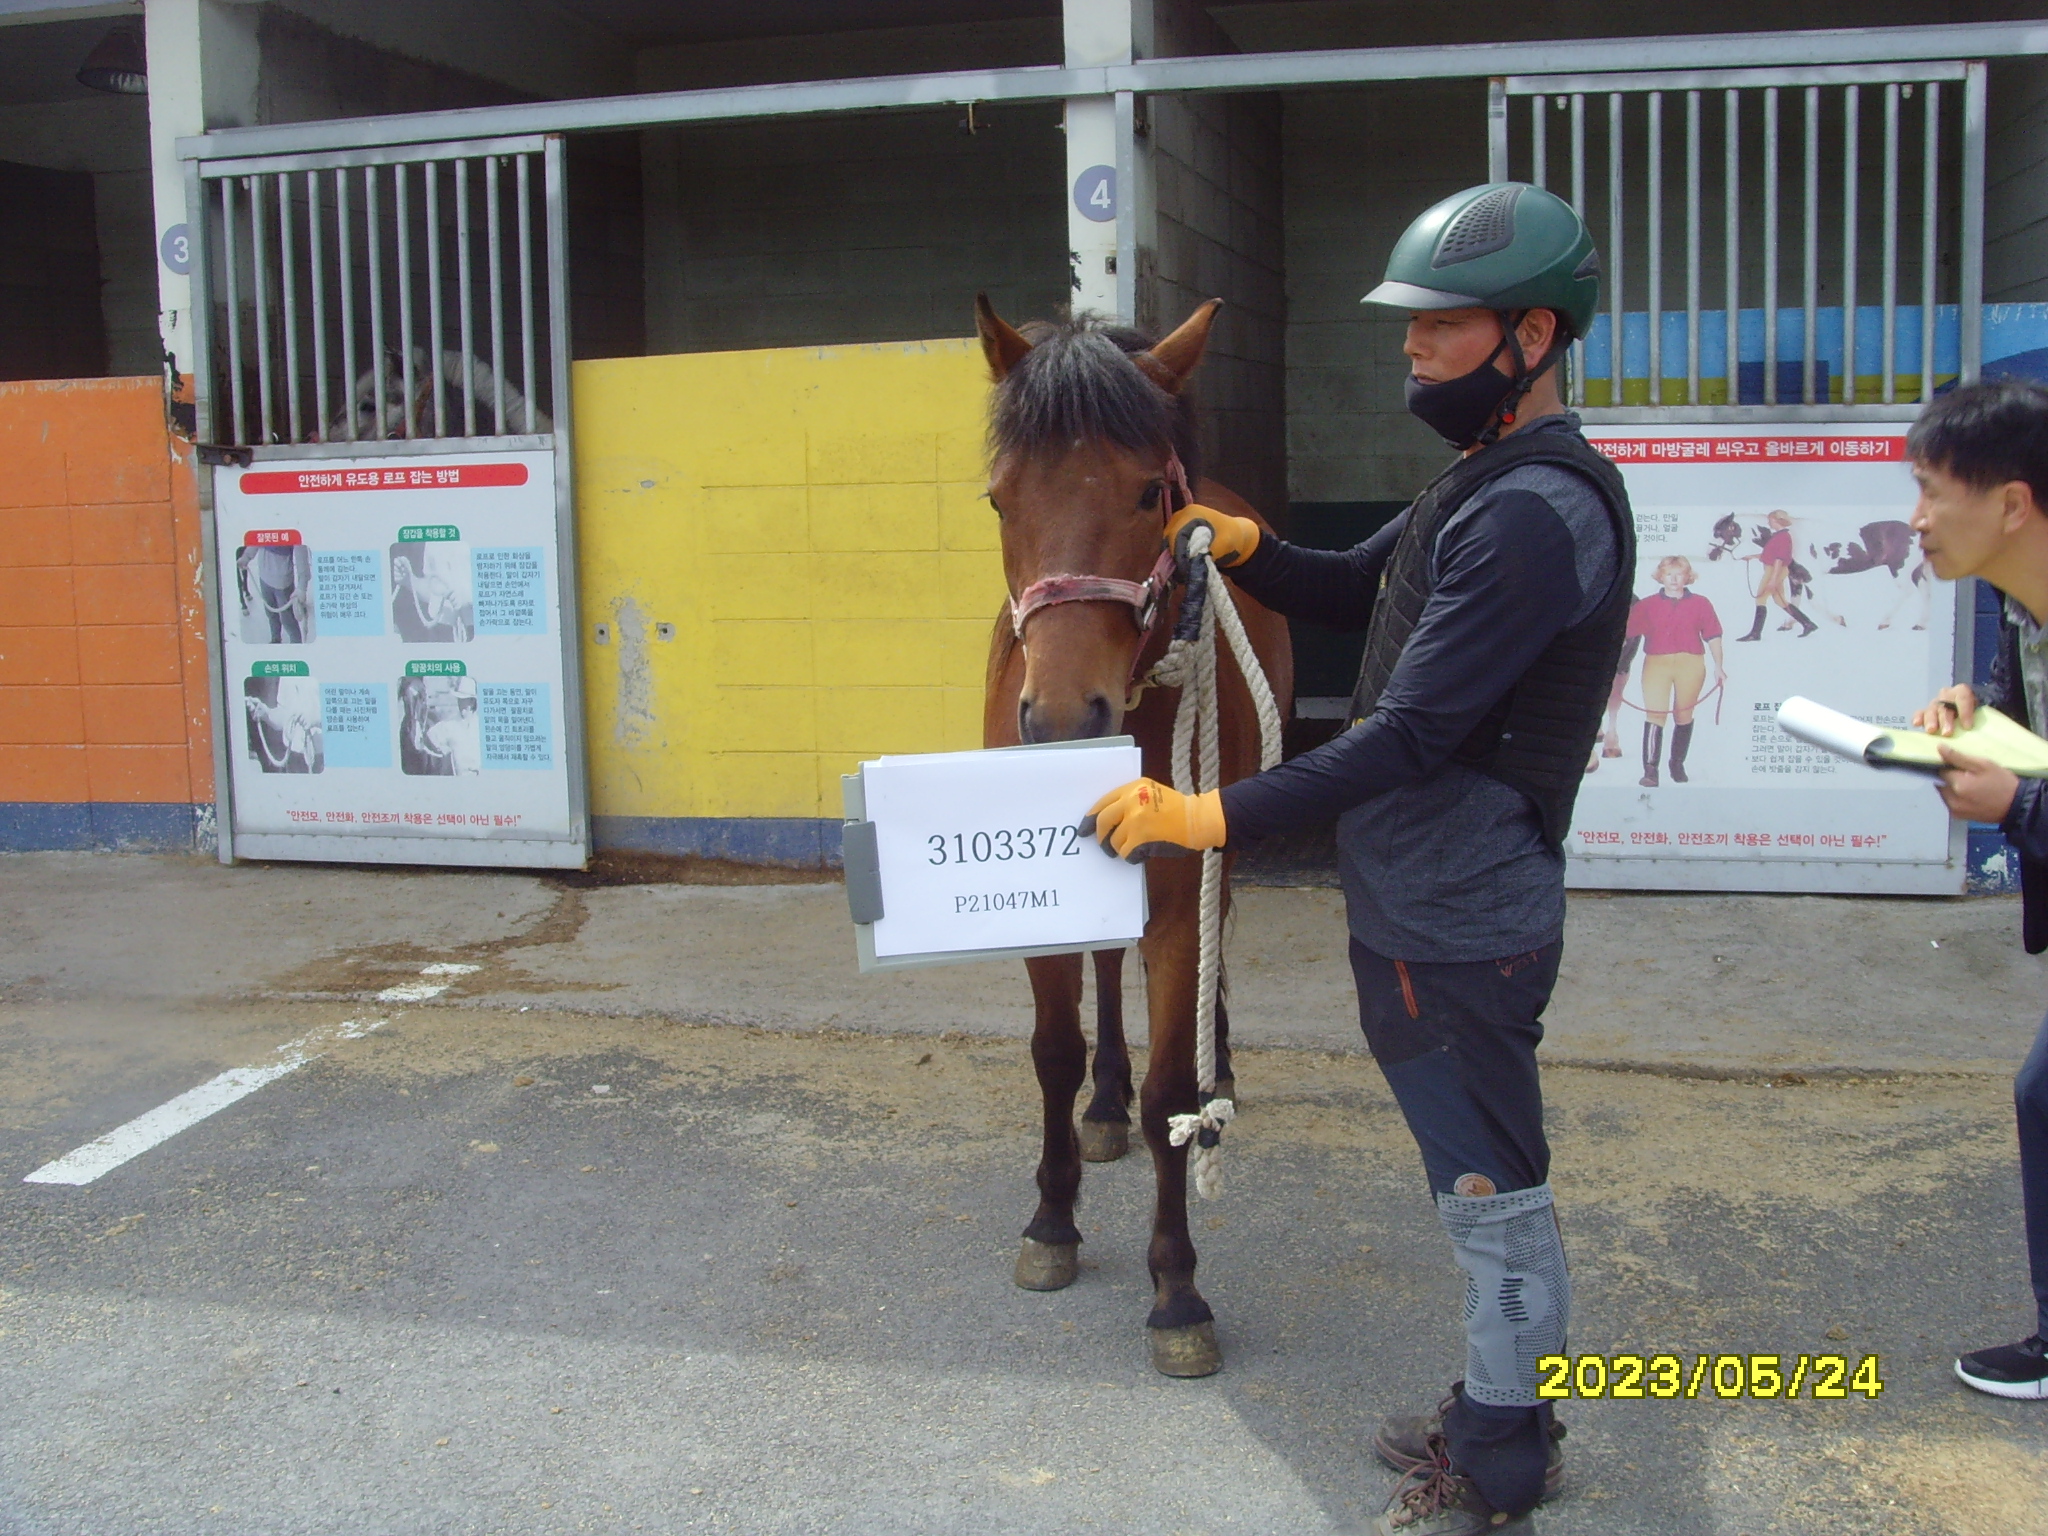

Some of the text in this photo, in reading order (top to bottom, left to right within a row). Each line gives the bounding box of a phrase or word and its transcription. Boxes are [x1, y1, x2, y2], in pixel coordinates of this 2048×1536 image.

[1091, 179, 1111, 208] 4
[174, 236, 189, 263] 3
[1652, 442, 1709, 457] 마방굴레
[1716, 442, 1759, 457] 씌우고
[1765, 441, 1824, 456] 올바르게
[1830, 441, 1890, 456] 이동하기
[298, 470, 459, 487] 안전하게 유도용 로프 잡는 방법
[1663, 514, 1678, 522] 만일
[257, 533, 289, 542] 잘못된 예
[403, 529, 423, 539] 장갑을
[448, 528, 455, 537] 것
[1644, 534, 1668, 542] 것이다.
[265, 664, 296, 673] 손의 위치
[411, 663, 460, 672] 팔꿈치의 사용
[1752, 715, 1774, 723] 로프는
[326, 811, 357, 823] 안전화,
[361, 812, 399, 824] 안전조끼
[404, 813, 432, 824] 착용은
[437, 814, 465, 825] 선택이
[470, 815, 489, 825] 아닌
[928, 825, 1081, 867] 3103372
[1577, 831, 1887, 847] “안전모, 안전화, 안전조끼 착용은 선택이 아닌 필수!”
[955, 889, 1060, 914] P21047M1
